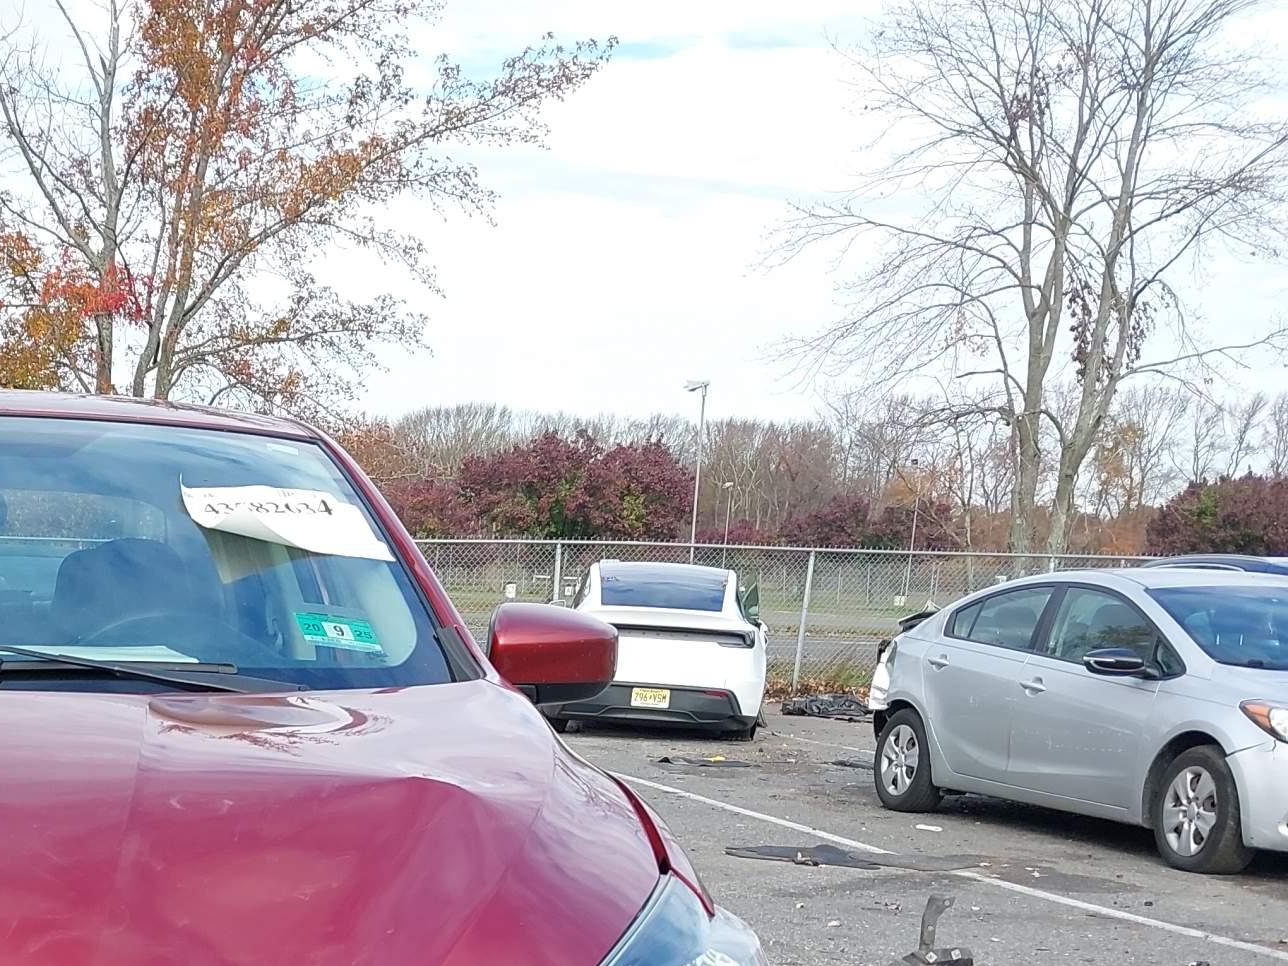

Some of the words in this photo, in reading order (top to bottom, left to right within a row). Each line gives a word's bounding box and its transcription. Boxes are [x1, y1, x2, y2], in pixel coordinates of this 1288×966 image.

[304, 622, 321, 632] 20
[333, 625, 345, 637] 9
[354, 629, 373, 640] 25
